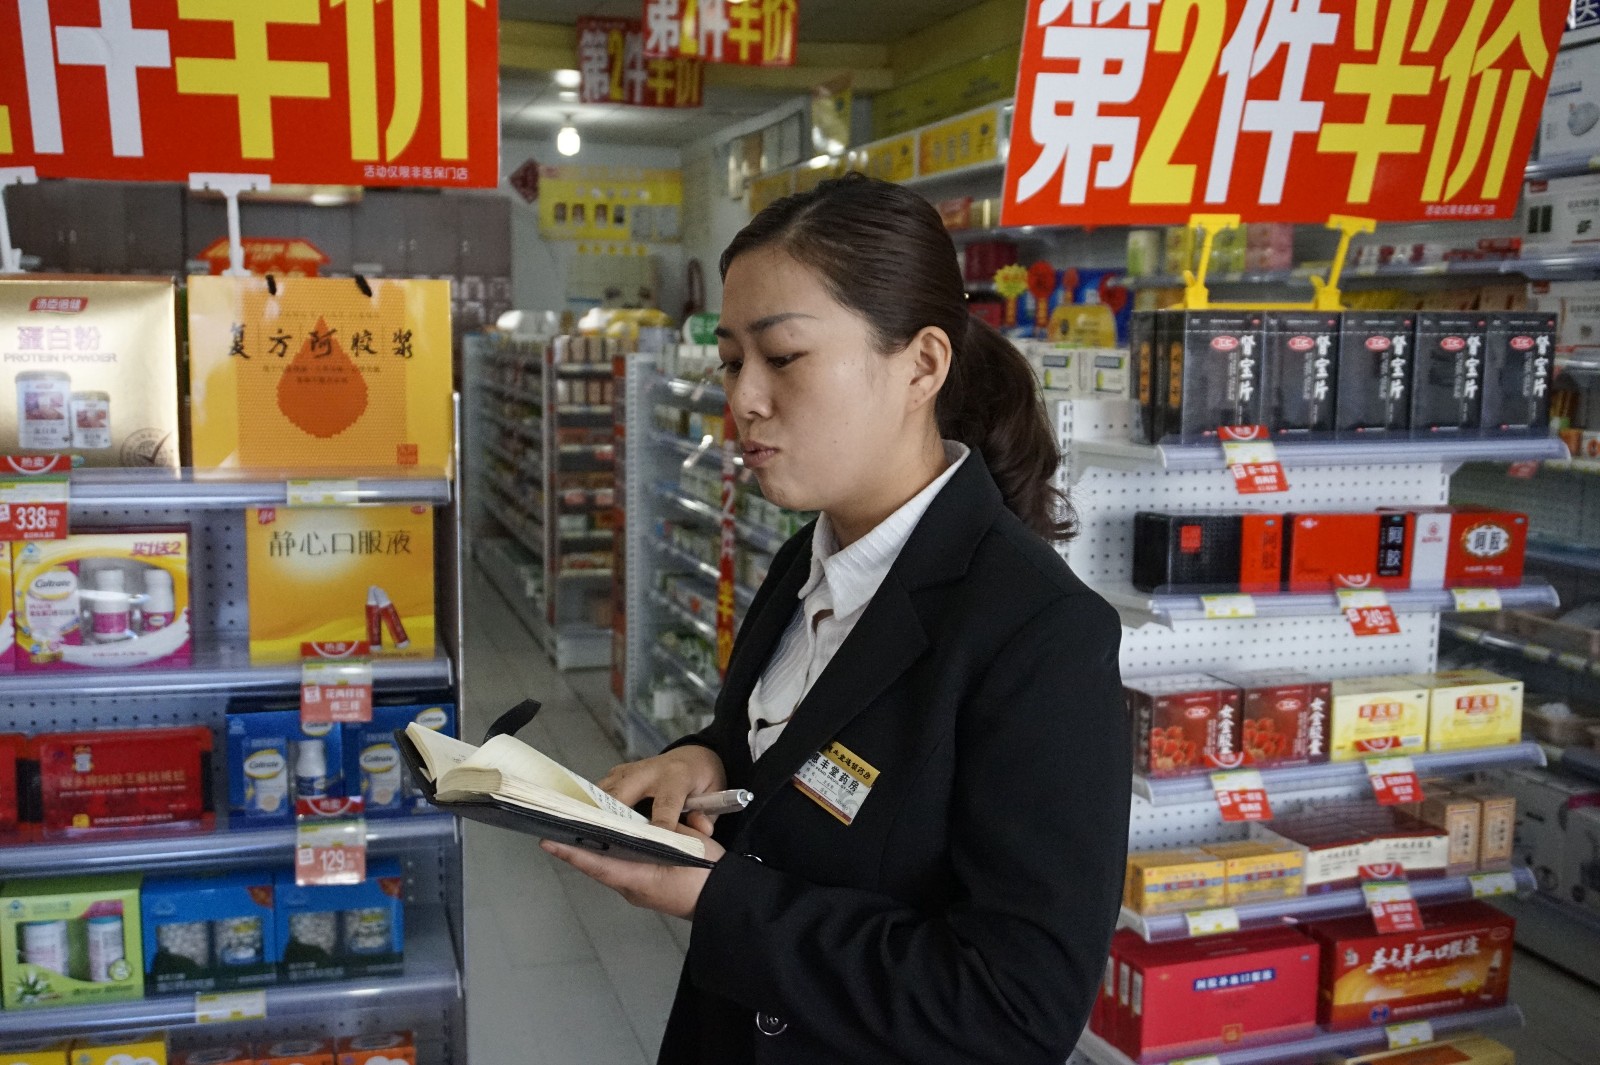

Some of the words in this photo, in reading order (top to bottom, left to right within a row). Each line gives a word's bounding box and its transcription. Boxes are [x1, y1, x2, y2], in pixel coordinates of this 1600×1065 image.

[1016, 0, 1549, 205] 第2件半价
[363, 165, 469, 180] 活动仅限非医保门店
[17, 326, 103, 351] 蛋白粉
[228, 322, 413, 360] 复方阿胶浆
[4, 353, 60, 363] PROTEIN
[63, 353, 118, 363] POWDER
[269, 529, 411, 557] 静心口服液
[1386, 526, 1404, 567] 阿胶
[1474, 531, 1502, 550] 阿胶
[34, 578, 71, 588] Caltrate
